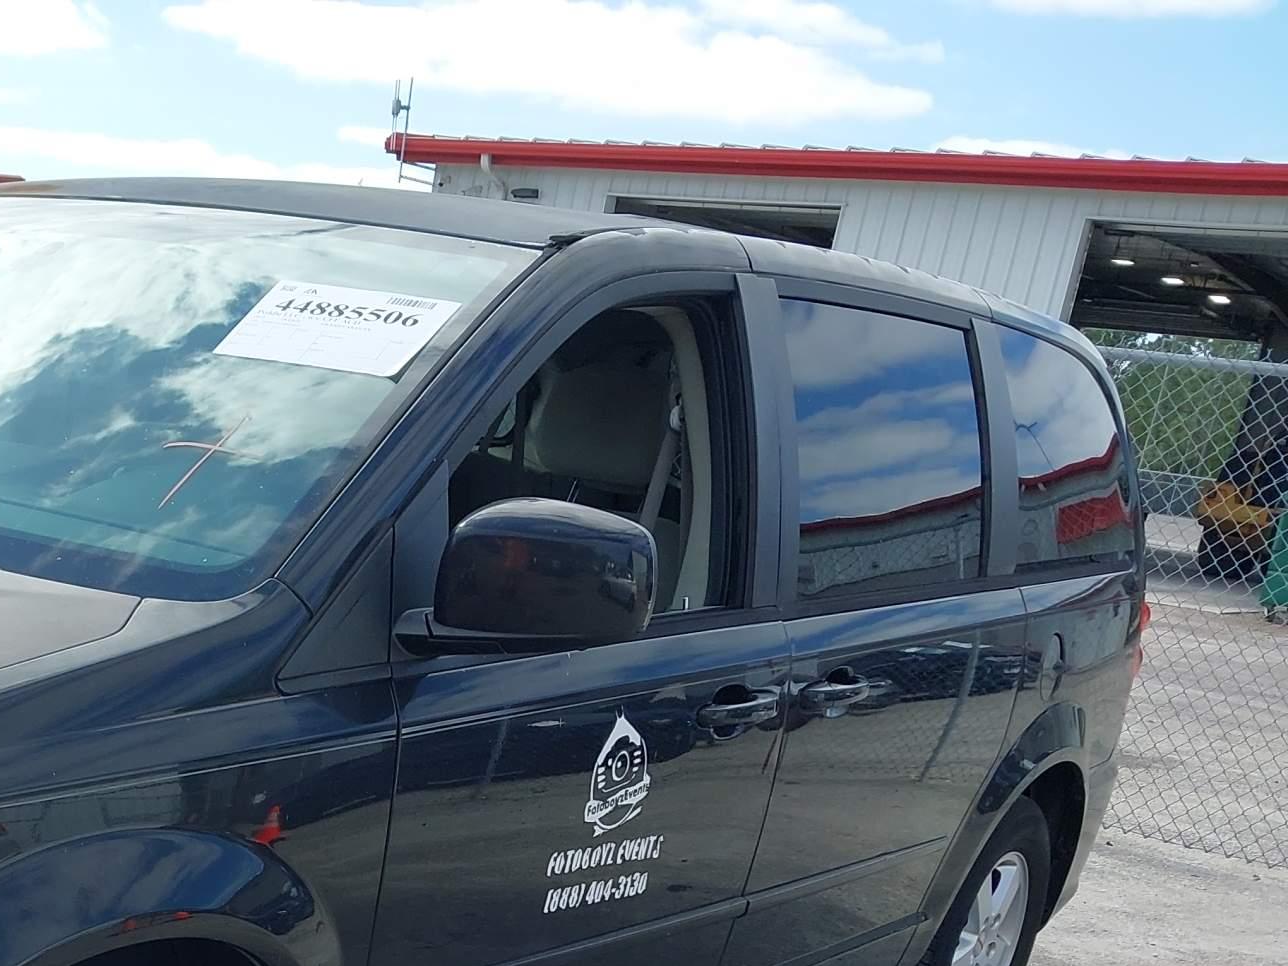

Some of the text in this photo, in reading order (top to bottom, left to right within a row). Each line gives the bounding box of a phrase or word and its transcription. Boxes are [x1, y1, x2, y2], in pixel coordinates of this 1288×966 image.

[275, 298, 424, 328] 44885506
[547, 835, 664, 876] FOTOBOYZ EVENTS
[543, 872, 649, 914] (888) 404-3130
